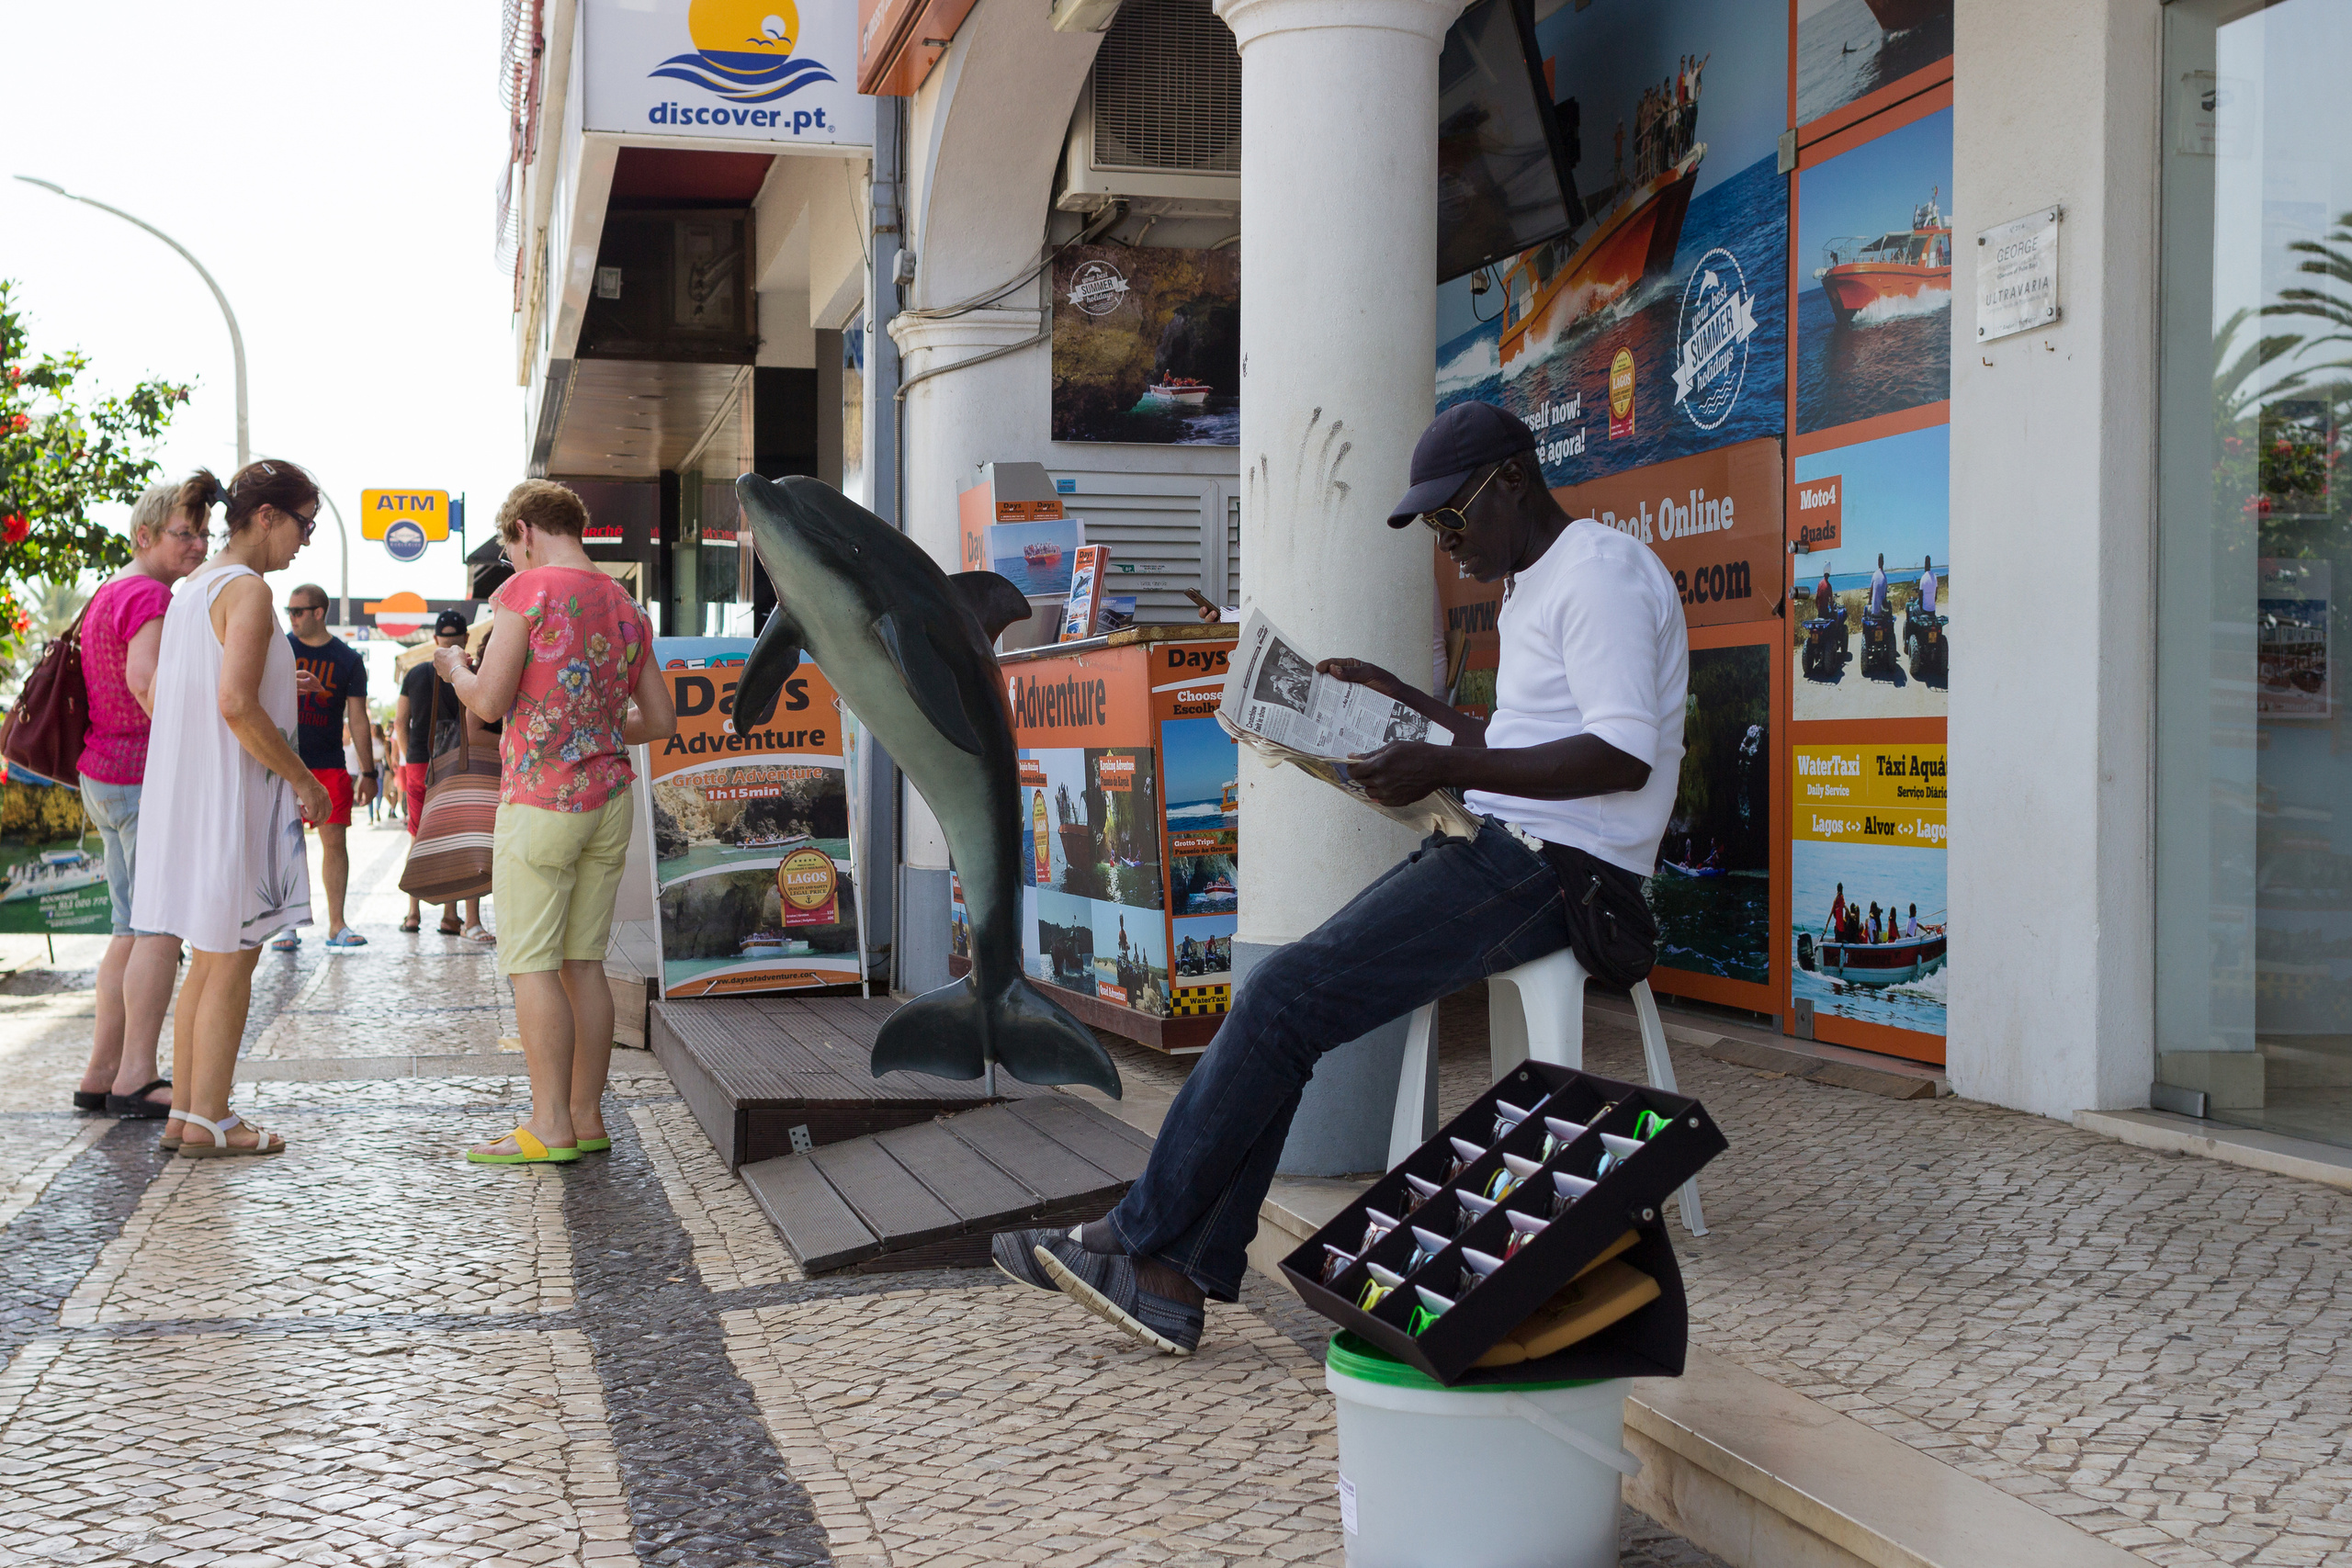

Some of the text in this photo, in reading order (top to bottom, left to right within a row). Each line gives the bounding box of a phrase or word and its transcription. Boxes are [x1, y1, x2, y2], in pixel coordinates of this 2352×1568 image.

[649, 102, 826, 134] discover.pt
[1996, 236, 2039, 263] GEORGE
[1080, 278, 1114, 295] SUMMER
[1086, 291, 1114, 303] holidays
[1985, 276, 2049, 306] ULTRAVARIA
[1691, 281, 1727, 333] your best
[1690, 304, 1735, 368] SUMMER
[1612, 372, 1631, 389] LAGOS
[1697, 345, 1734, 393] holidays
[1551, 391, 1580, 425] now!
[1547, 427, 1586, 466] agora!
[377, 495, 435, 511] ATM
[1800, 484, 1836, 510] Moto4
[1658, 488, 1734, 541] Online
[1800, 520, 1836, 542] Quads
[967, 531, 985, 570] Day
[1080, 551, 1092, 559] Days
[1168, 649, 1227, 671] Days
[1016, 673, 1106, 728] Adventure
[1177, 690, 1223, 702] Choose
[663, 728, 826, 756] Adventure
[672, 767, 823, 787] Grotto Adventure
[1100, 759, 1135, 773] Kayaking Adventure
[1797, 753, 1948, 783] WaterTaxi Táxi Aquá
[707, 786, 780, 800] 1h15min
[1807, 784, 1824, 798] Daily
[1825, 784, 1849, 796] Service
[1897, 785, 1924, 800] Serviço
[1812, 814, 1843, 838] Lagos
[1863, 816, 1895, 836] Alvor
[1916, 818, 1948, 843] Lago
[787, 871, 827, 885] LAGOS
[1108, 987, 1126, 1001] Adventure
[1189, 995, 1227, 1005] WaterTaxi
